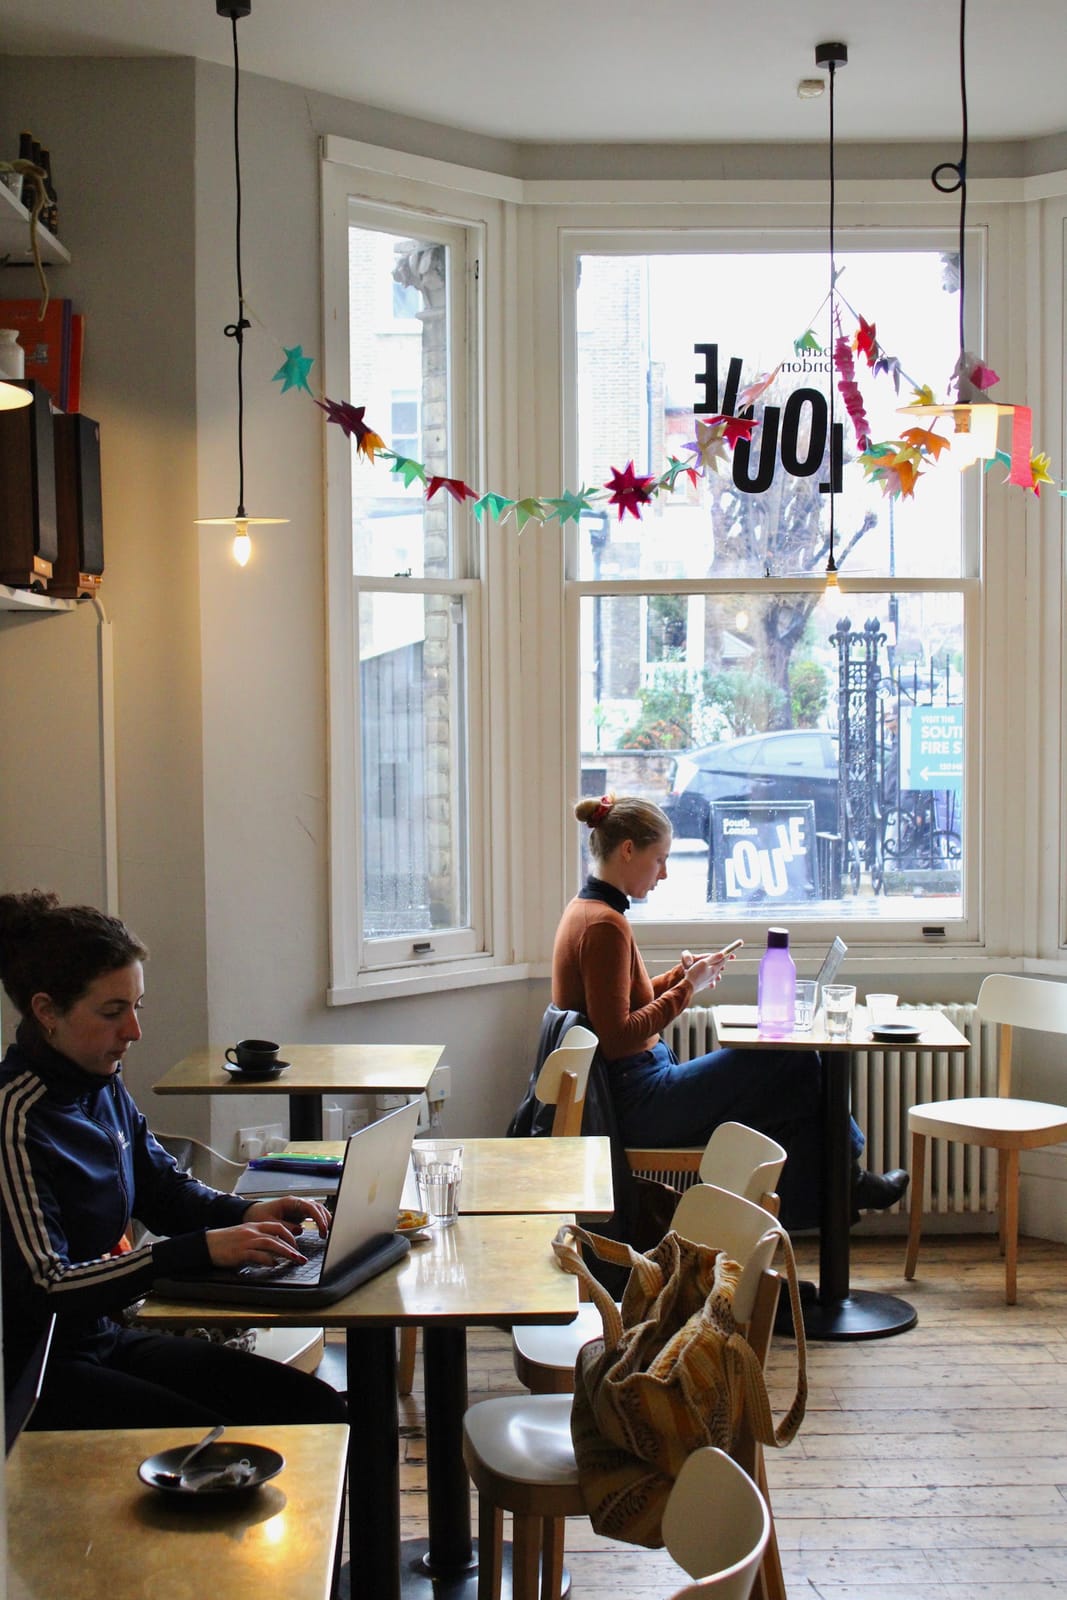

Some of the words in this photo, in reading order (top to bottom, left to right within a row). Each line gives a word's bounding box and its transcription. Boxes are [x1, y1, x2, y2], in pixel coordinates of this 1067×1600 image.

[940, 715, 956, 724] THE
[920, 740, 950, 755] FIRE
[722, 817, 750, 827] South
[722, 826, 758, 835] London
[724, 816, 808, 898] LOUIE
